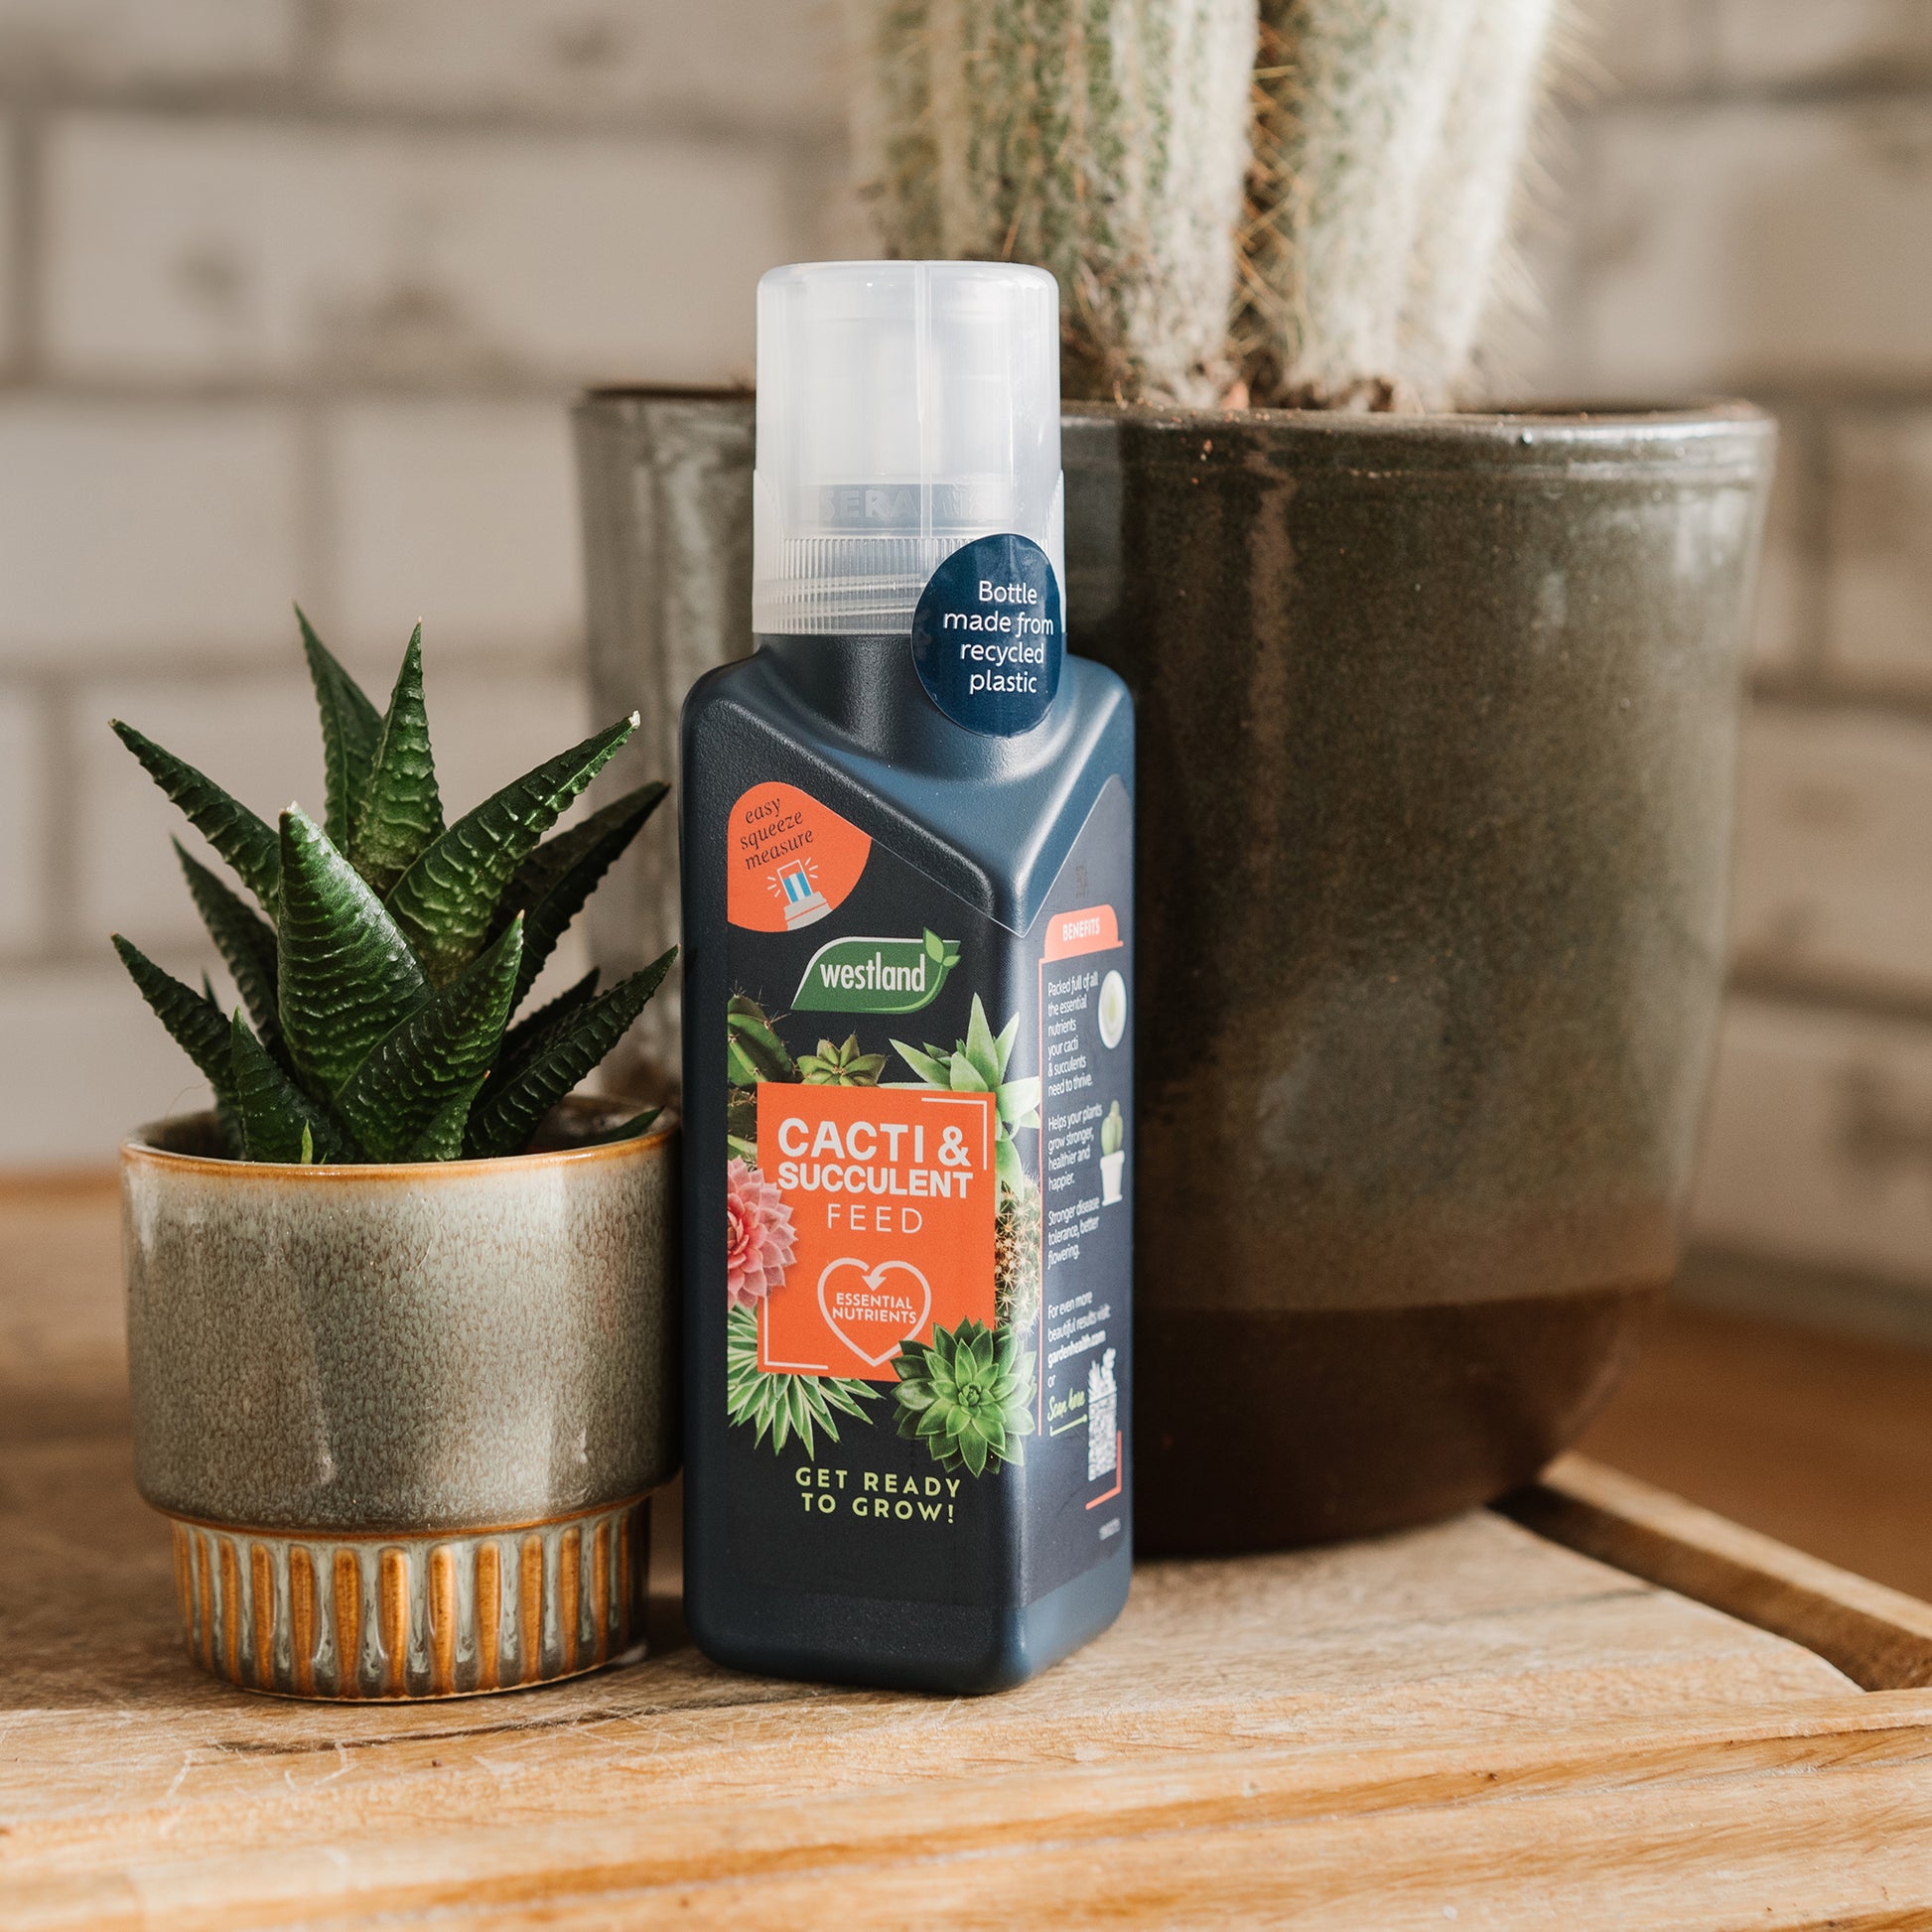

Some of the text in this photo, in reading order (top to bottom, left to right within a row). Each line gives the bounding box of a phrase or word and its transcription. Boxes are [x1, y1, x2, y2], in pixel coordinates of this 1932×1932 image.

[978, 580, 1037, 605] Bottle
[943, 611, 1054, 638] made from
[960, 641, 1044, 667] recycled
[969, 669, 1037, 695] plastic
[745, 798, 780, 824] easy
[740, 811, 803, 850] squeeze
[745, 830, 814, 871] measure
[1062, 916, 1101, 942] BENEFITS
[819, 951, 926, 992] westland
[1047, 970, 1099, 997] Packed full of all
[1047, 994, 1087, 1018] the essential
[1047, 1018, 1077, 1037] nutrients
[1047, 1035, 1079, 1061] your cacti
[1047, 1054, 1087, 1078] & succulents
[1047, 1072, 1093, 1097] need to thrive.
[1047, 1103, 1103, 1132] Helps your plants
[778, 1117, 972, 1168] CACTI &
[1047, 1127, 1094, 1155] grow stronger,
[1047, 1144, 1091, 1172] healthier and
[777, 1161, 974, 1199] SUCCULENT
[1047, 1171, 1075, 1191] happier.
[827, 1203, 923, 1234] FEED
[1047, 1197, 1100, 1227] Stronger disease
[1047, 1216, 1100, 1246] tolerance, better
[1047, 1244, 1080, 1271] flowering.
[835, 1292, 912, 1310] ESSENTIAL
[1047, 1291, 1093, 1319] For even more
[832, 1307, 916, 1324] NUTRIENTS
[1047, 1317, 1077, 1343] beautiful
[1047, 1374, 1056, 1388] or
[795, 1466, 961, 1498] GET READY
[801, 1492, 954, 1524] TO GROW!
